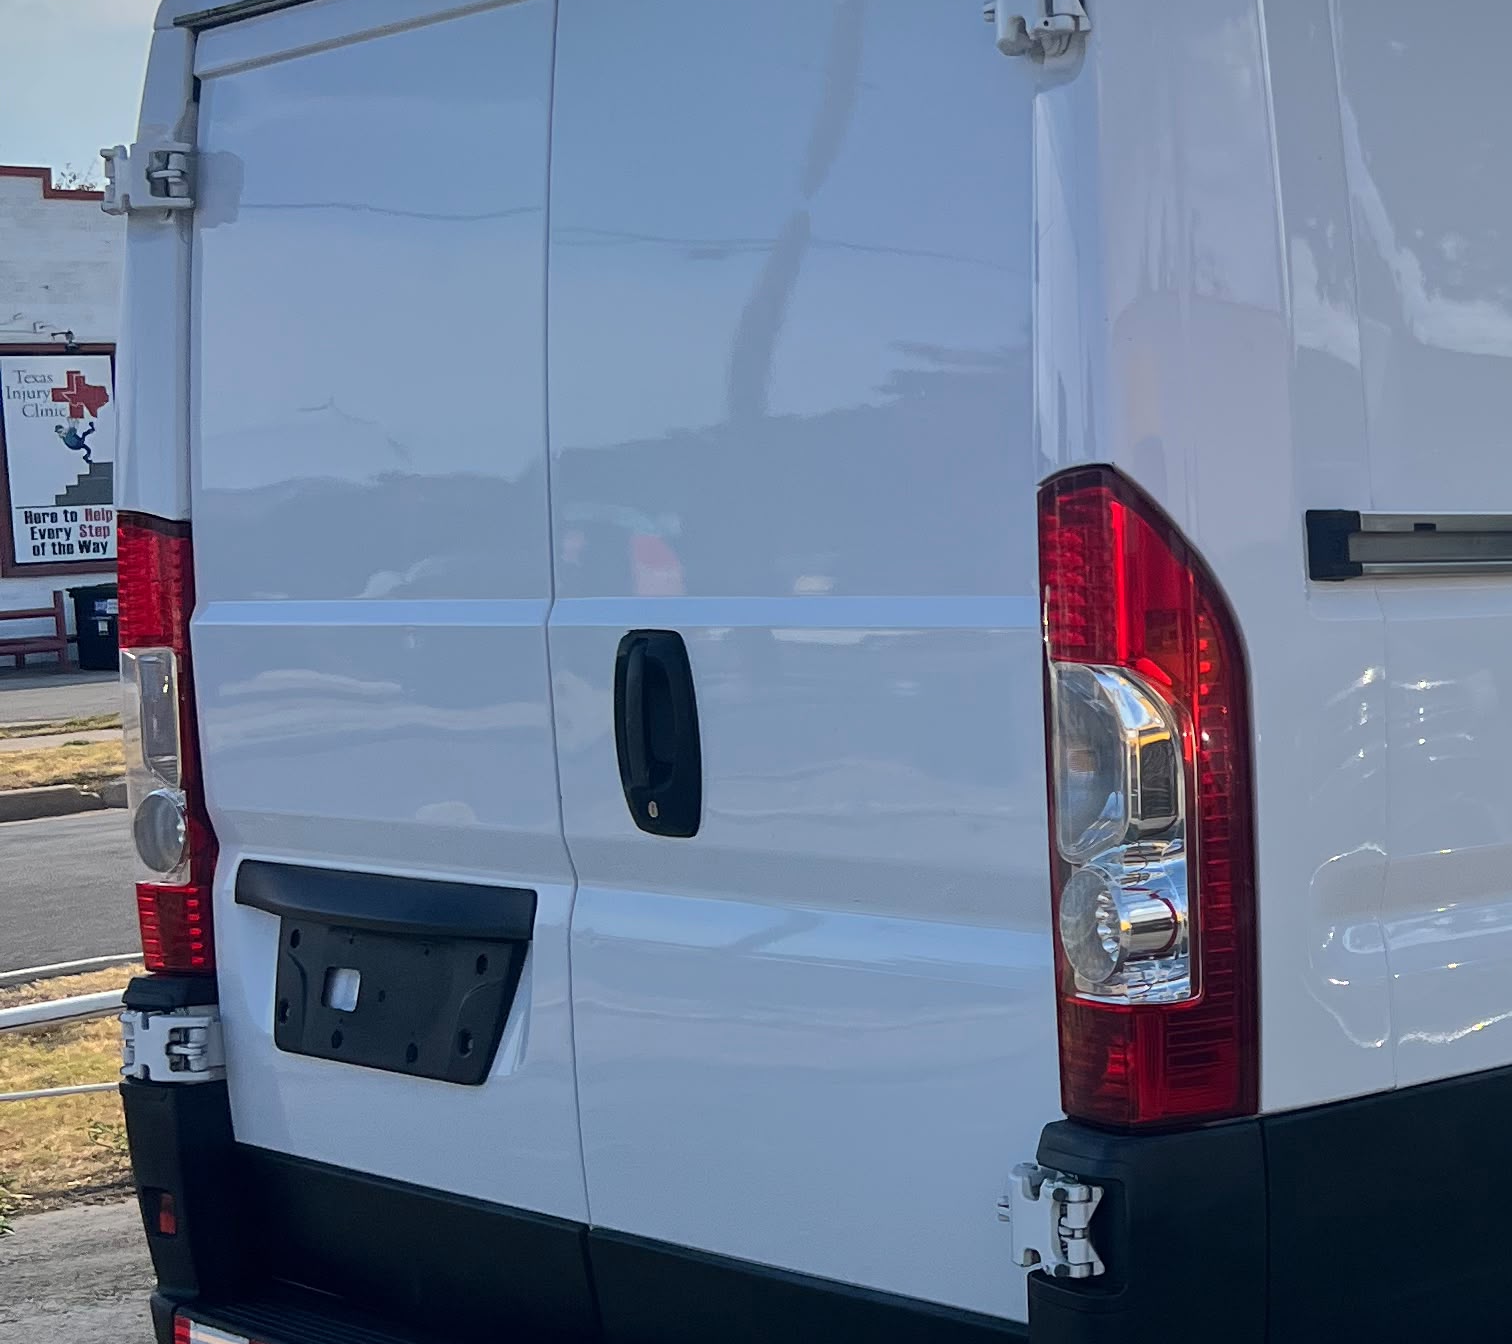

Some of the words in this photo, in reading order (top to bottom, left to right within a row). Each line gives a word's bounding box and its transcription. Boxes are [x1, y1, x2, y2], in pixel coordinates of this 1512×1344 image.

[13, 369, 54, 384] Texas
[6, 386, 50, 403] Injury
[22, 403, 67, 418] Clinic
[24, 511, 58, 524] Here
[62, 509, 78, 523] to
[84, 508, 113, 523] Help
[30, 526, 72, 541] Every
[79, 524, 110, 539] Step
[32, 542, 46, 556] of
[51, 542, 74, 555] the
[78, 540, 108, 555] Way
